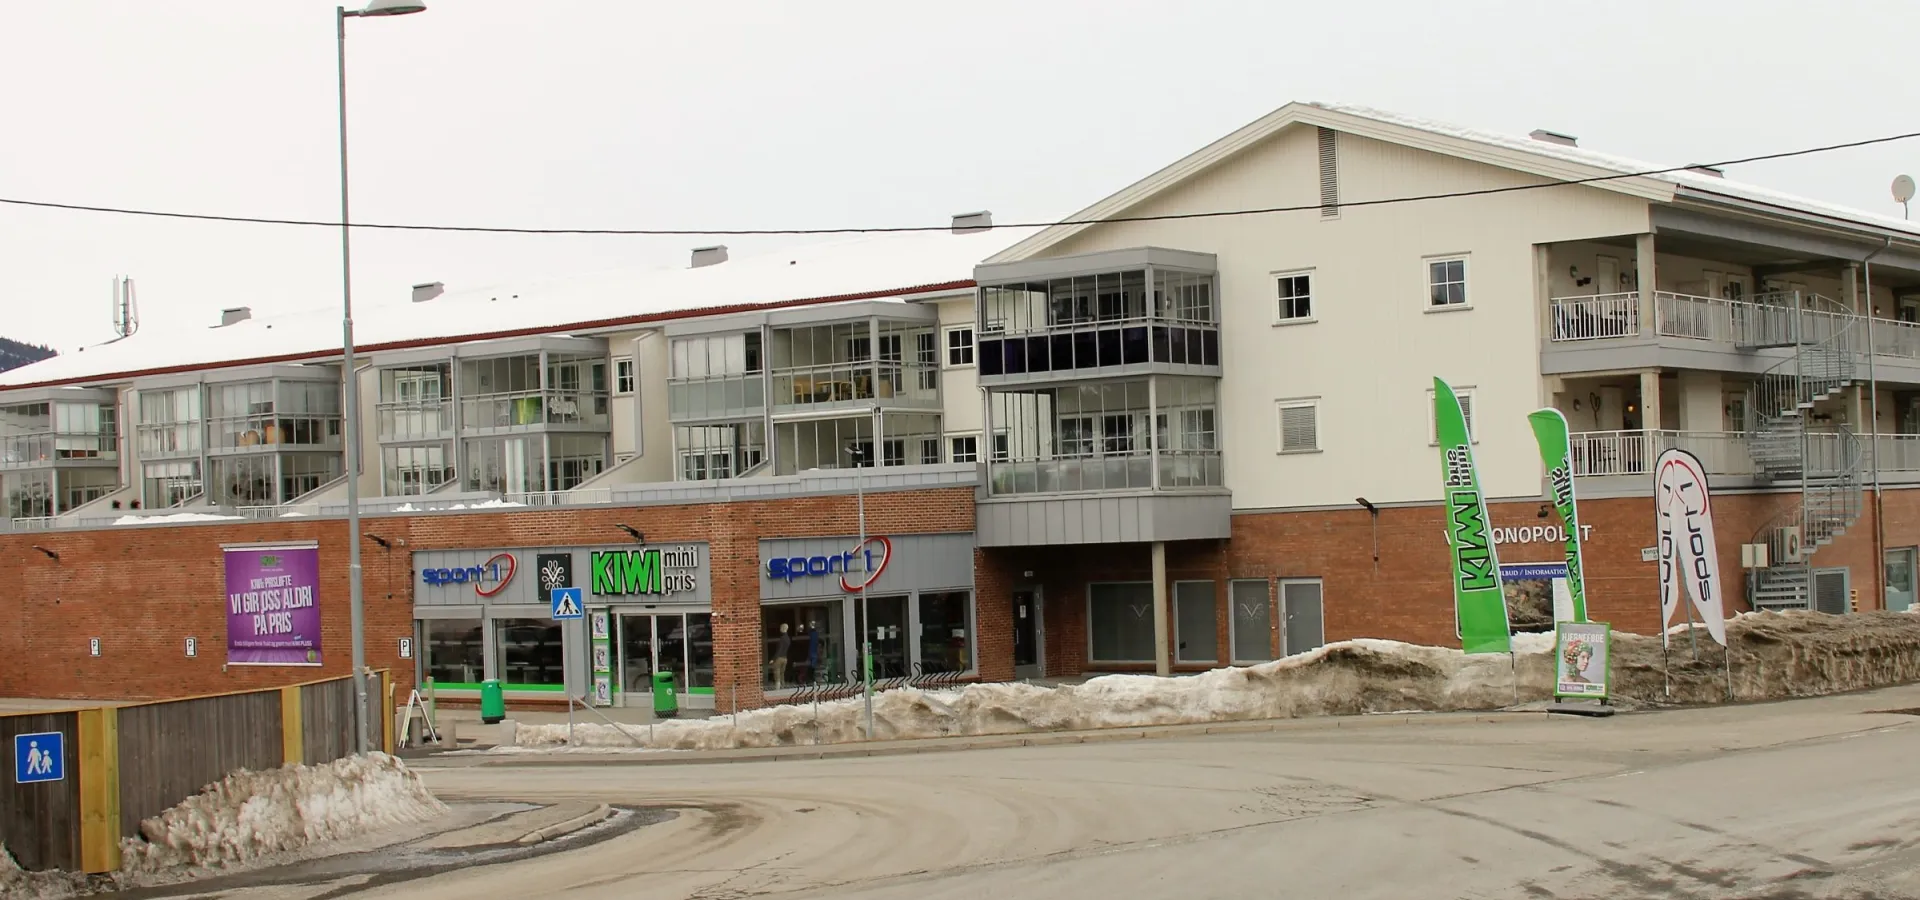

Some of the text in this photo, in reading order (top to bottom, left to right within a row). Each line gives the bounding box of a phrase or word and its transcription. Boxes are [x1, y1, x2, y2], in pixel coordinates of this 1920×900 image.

[664, 545, 698, 568] mini
[766, 551, 853, 583] sport
[1685, 505, 1711, 602] sport
[422, 563, 487, 587] sport
[591, 549, 664, 597] KIWI
[665, 571, 696, 596] pris
[230, 593, 242, 614] VI
[243, 591, 260, 613] GIR
[283, 585, 313, 609] ALDRI
[269, 612, 292, 634] PRIS
